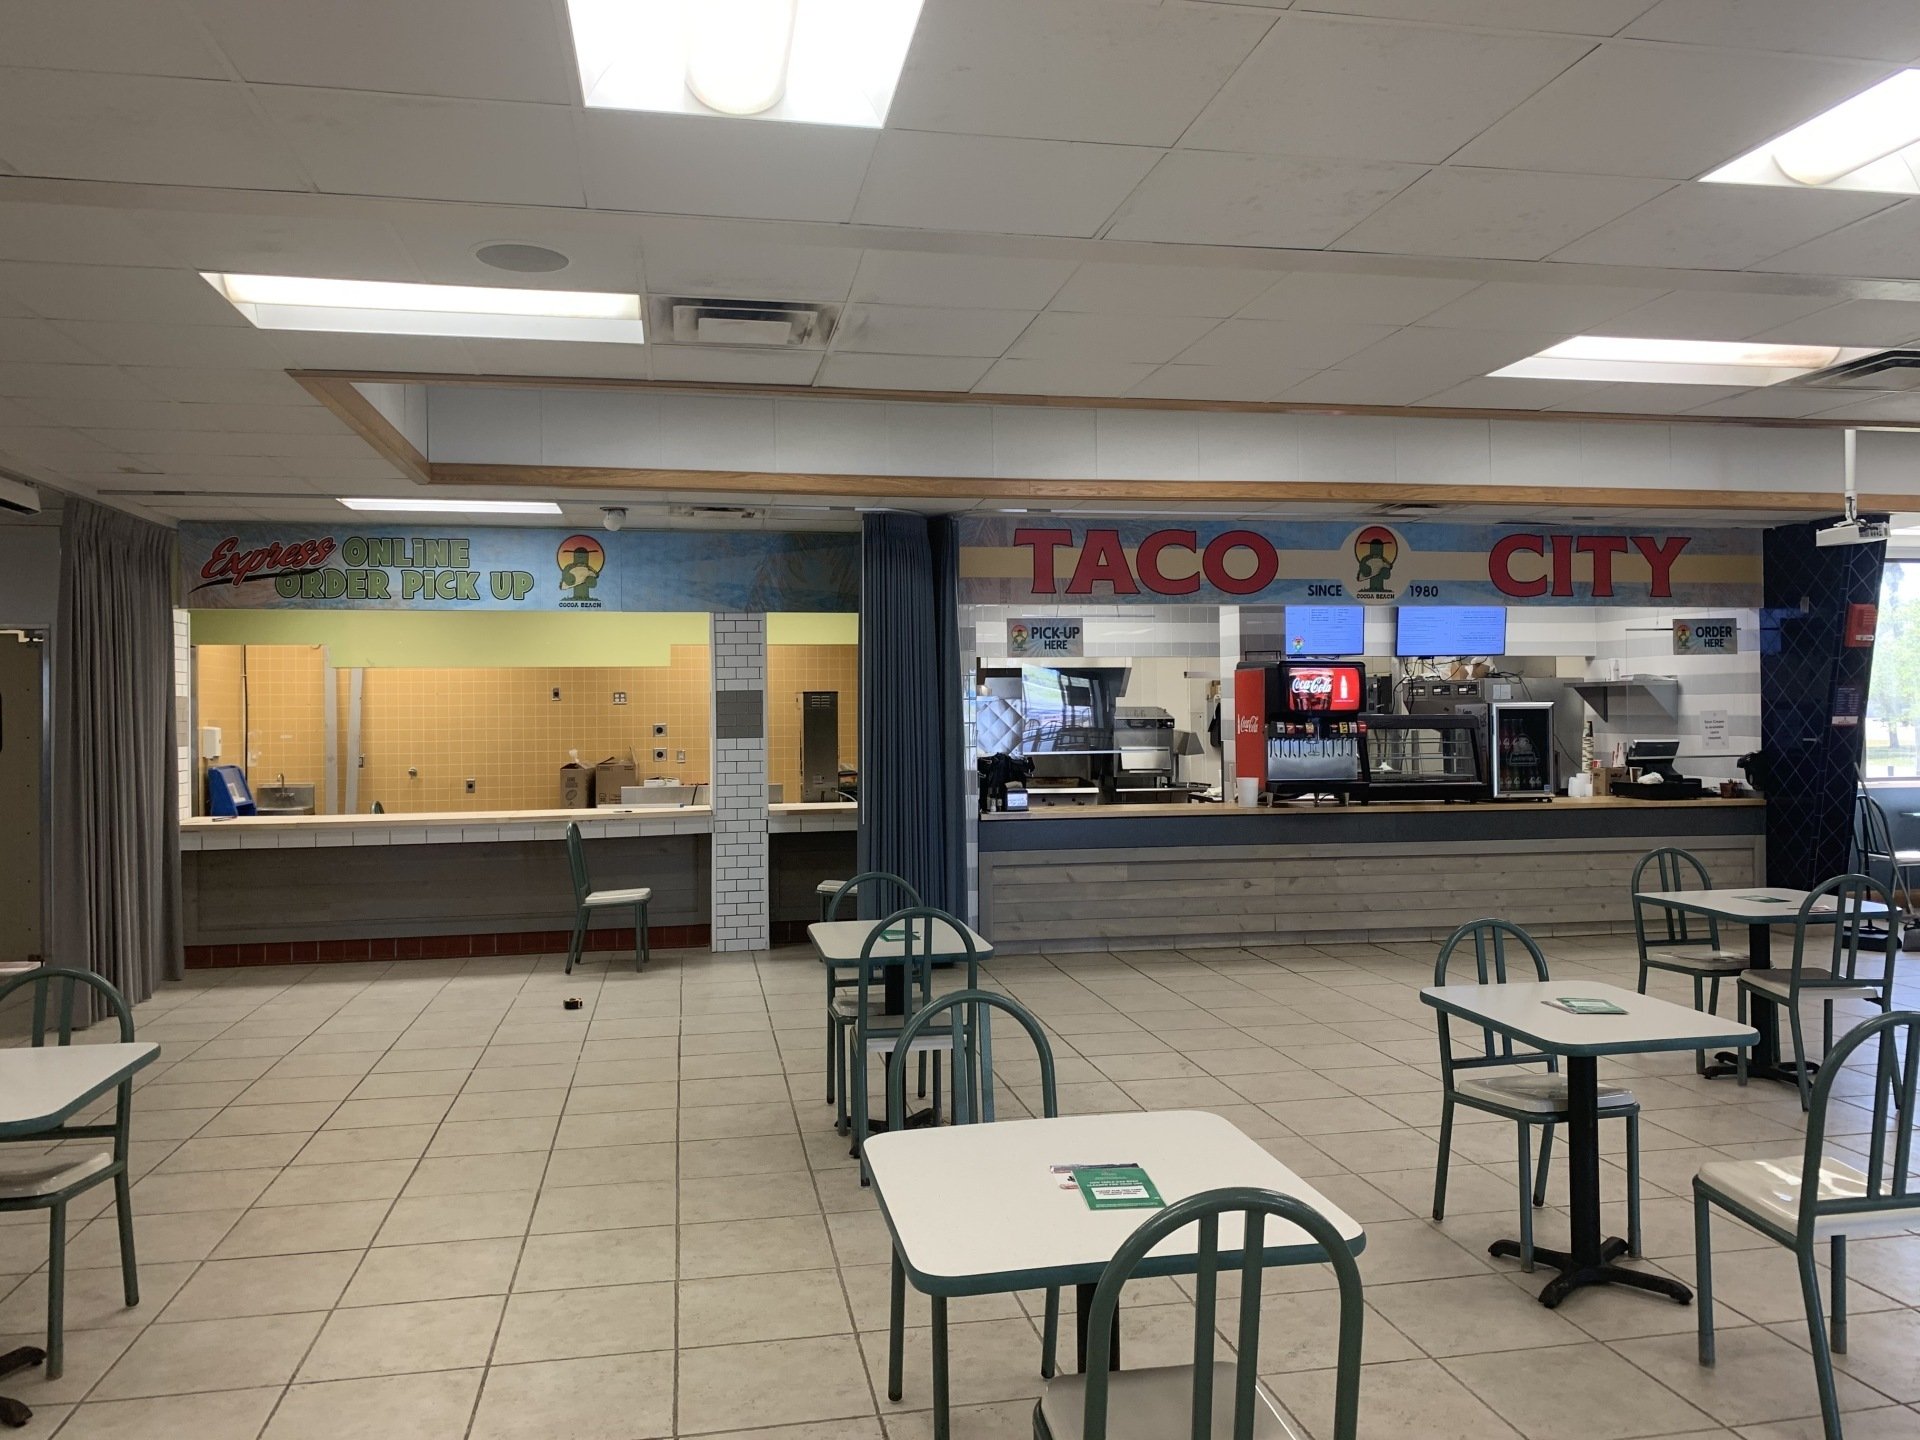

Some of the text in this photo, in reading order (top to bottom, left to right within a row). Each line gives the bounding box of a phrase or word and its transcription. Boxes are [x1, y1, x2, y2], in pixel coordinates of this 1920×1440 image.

[200, 536, 337, 587] Express
[1013, 528, 1692, 598] TACO CITY
[275, 568, 391, 600] ORDER
[490, 570, 534, 600] UP
[1307, 584, 1439, 598] SINCE 1980
[1031, 626, 1080, 639] PICK-UP
[1695, 626, 1732, 638] ORDER
[1044, 640, 1068, 650] HERE
[1704, 638, 1724, 648] HERE
